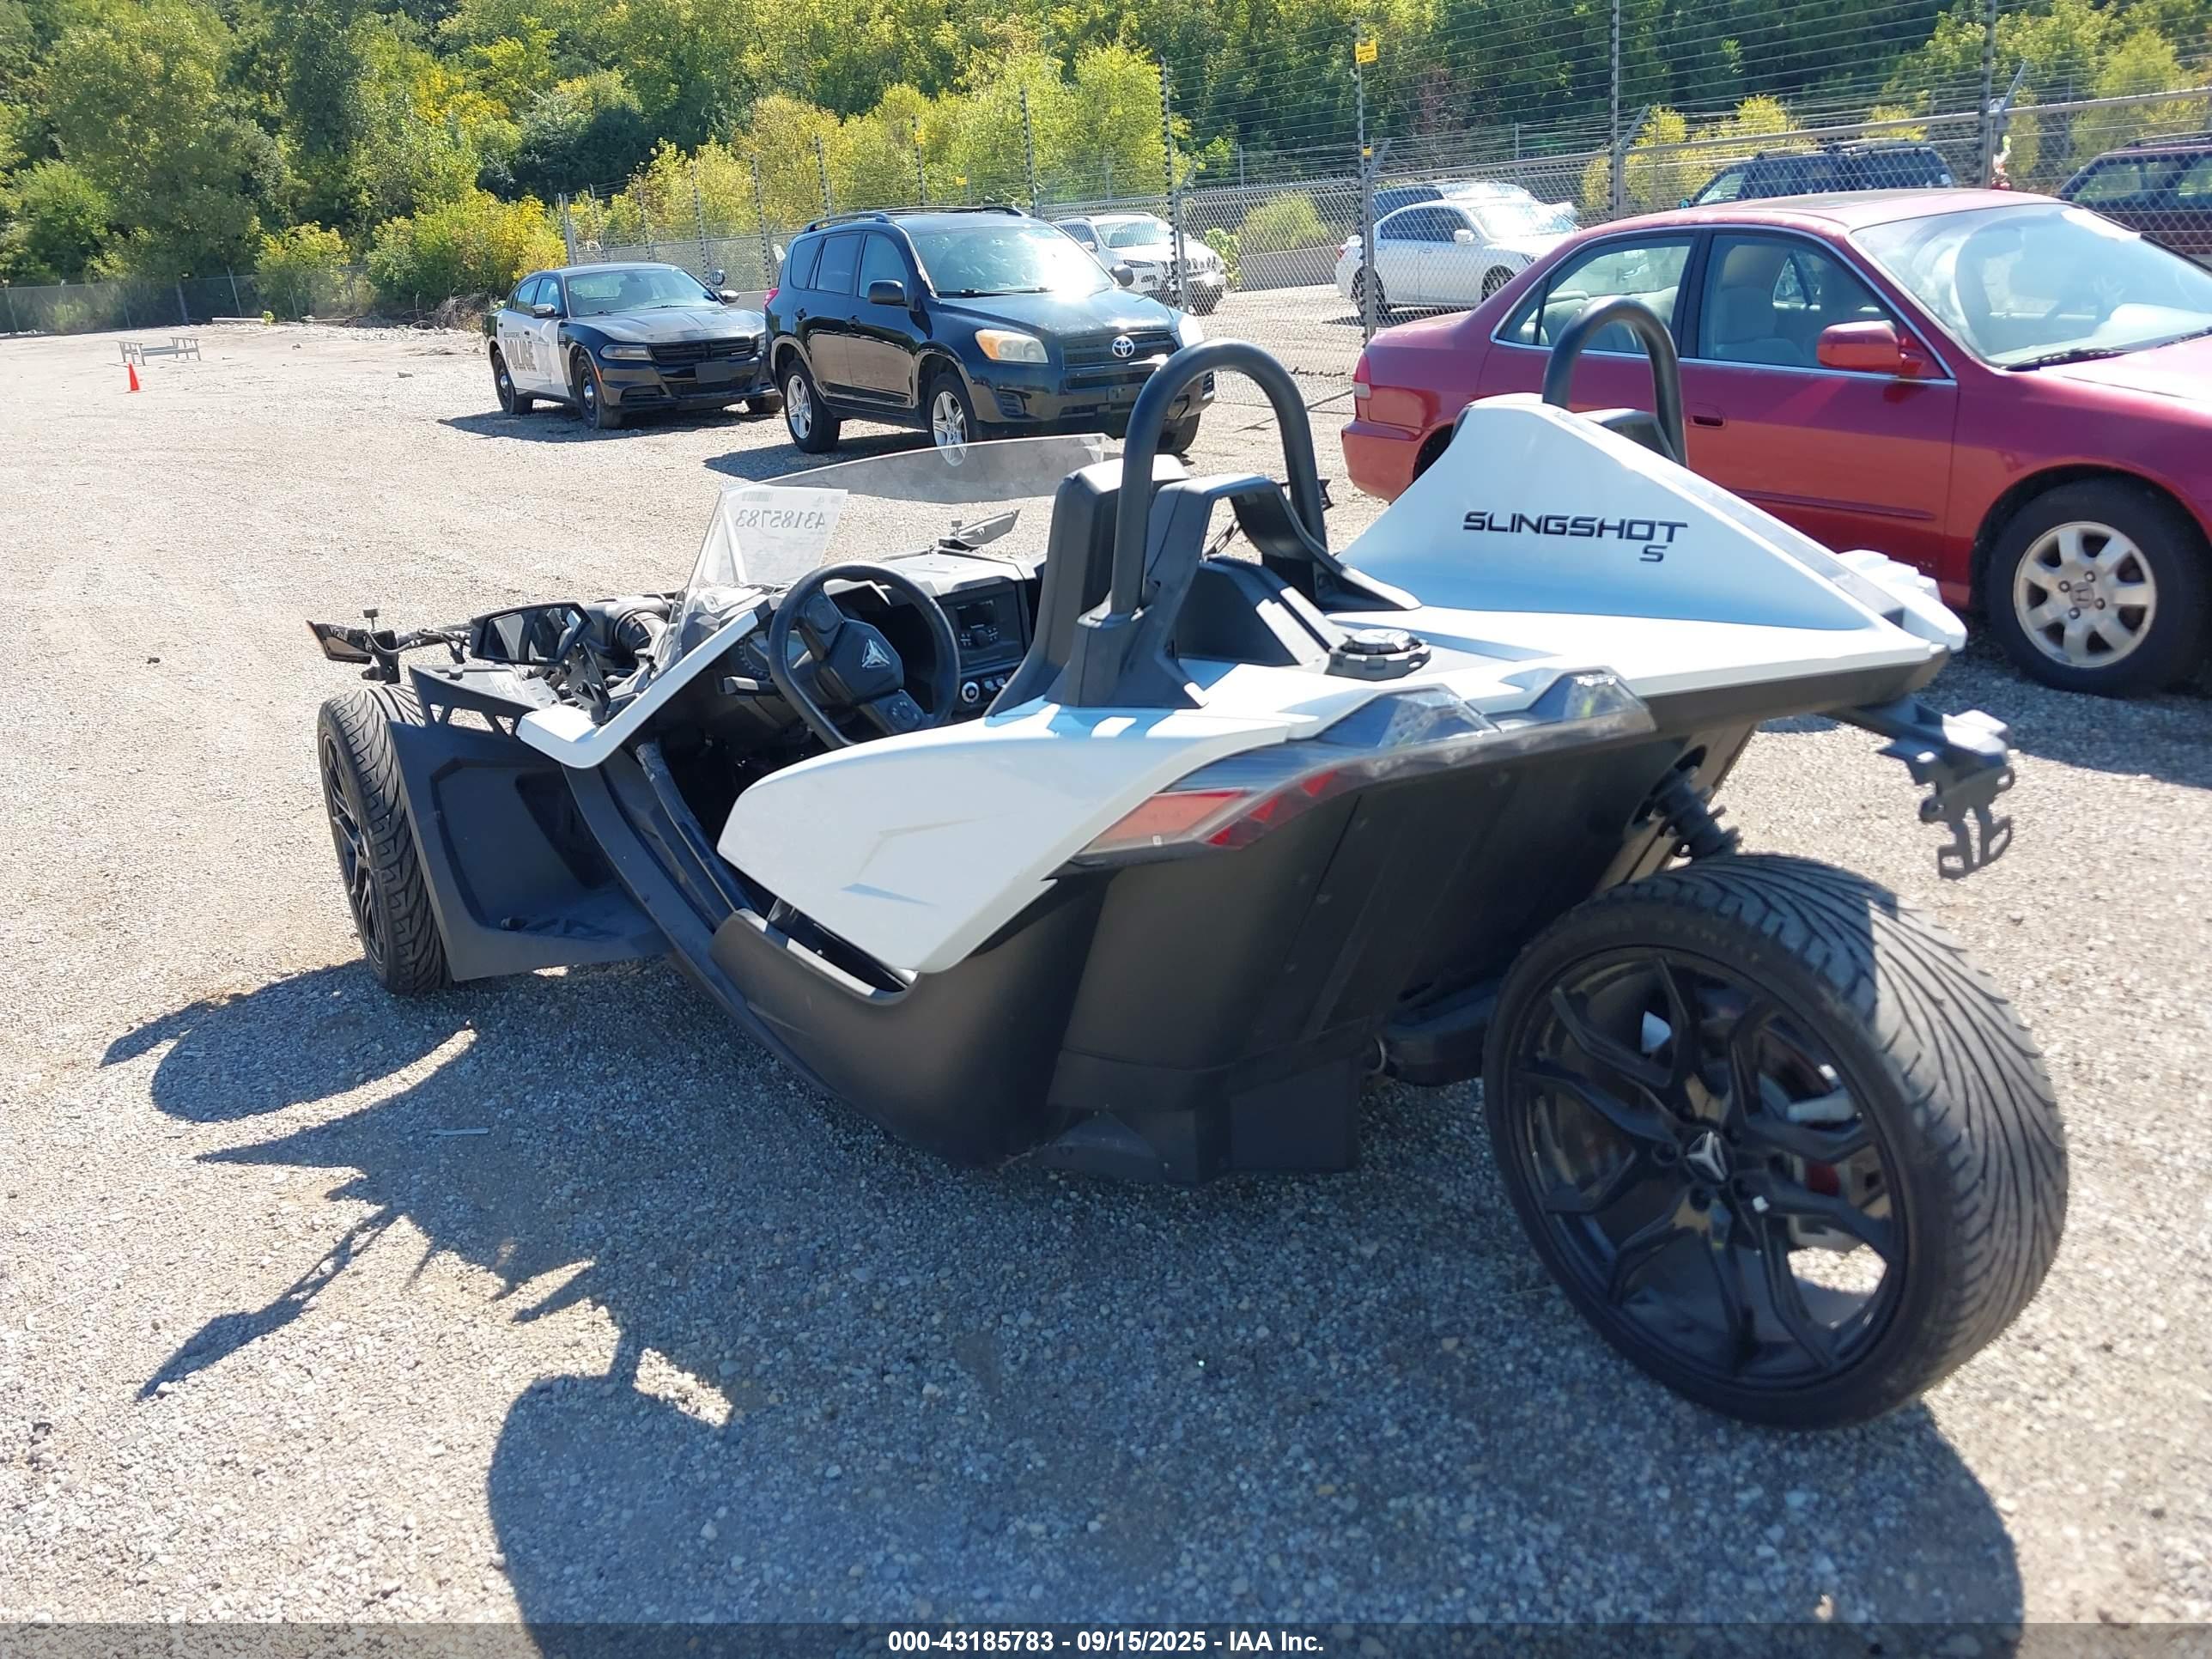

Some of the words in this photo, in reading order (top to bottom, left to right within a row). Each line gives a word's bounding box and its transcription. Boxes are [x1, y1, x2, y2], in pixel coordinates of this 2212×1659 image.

[504, 339, 538, 372] POLICE
[1462, 511, 1688, 543] SLINGSHOT
[1639, 544, 1668, 562] S
